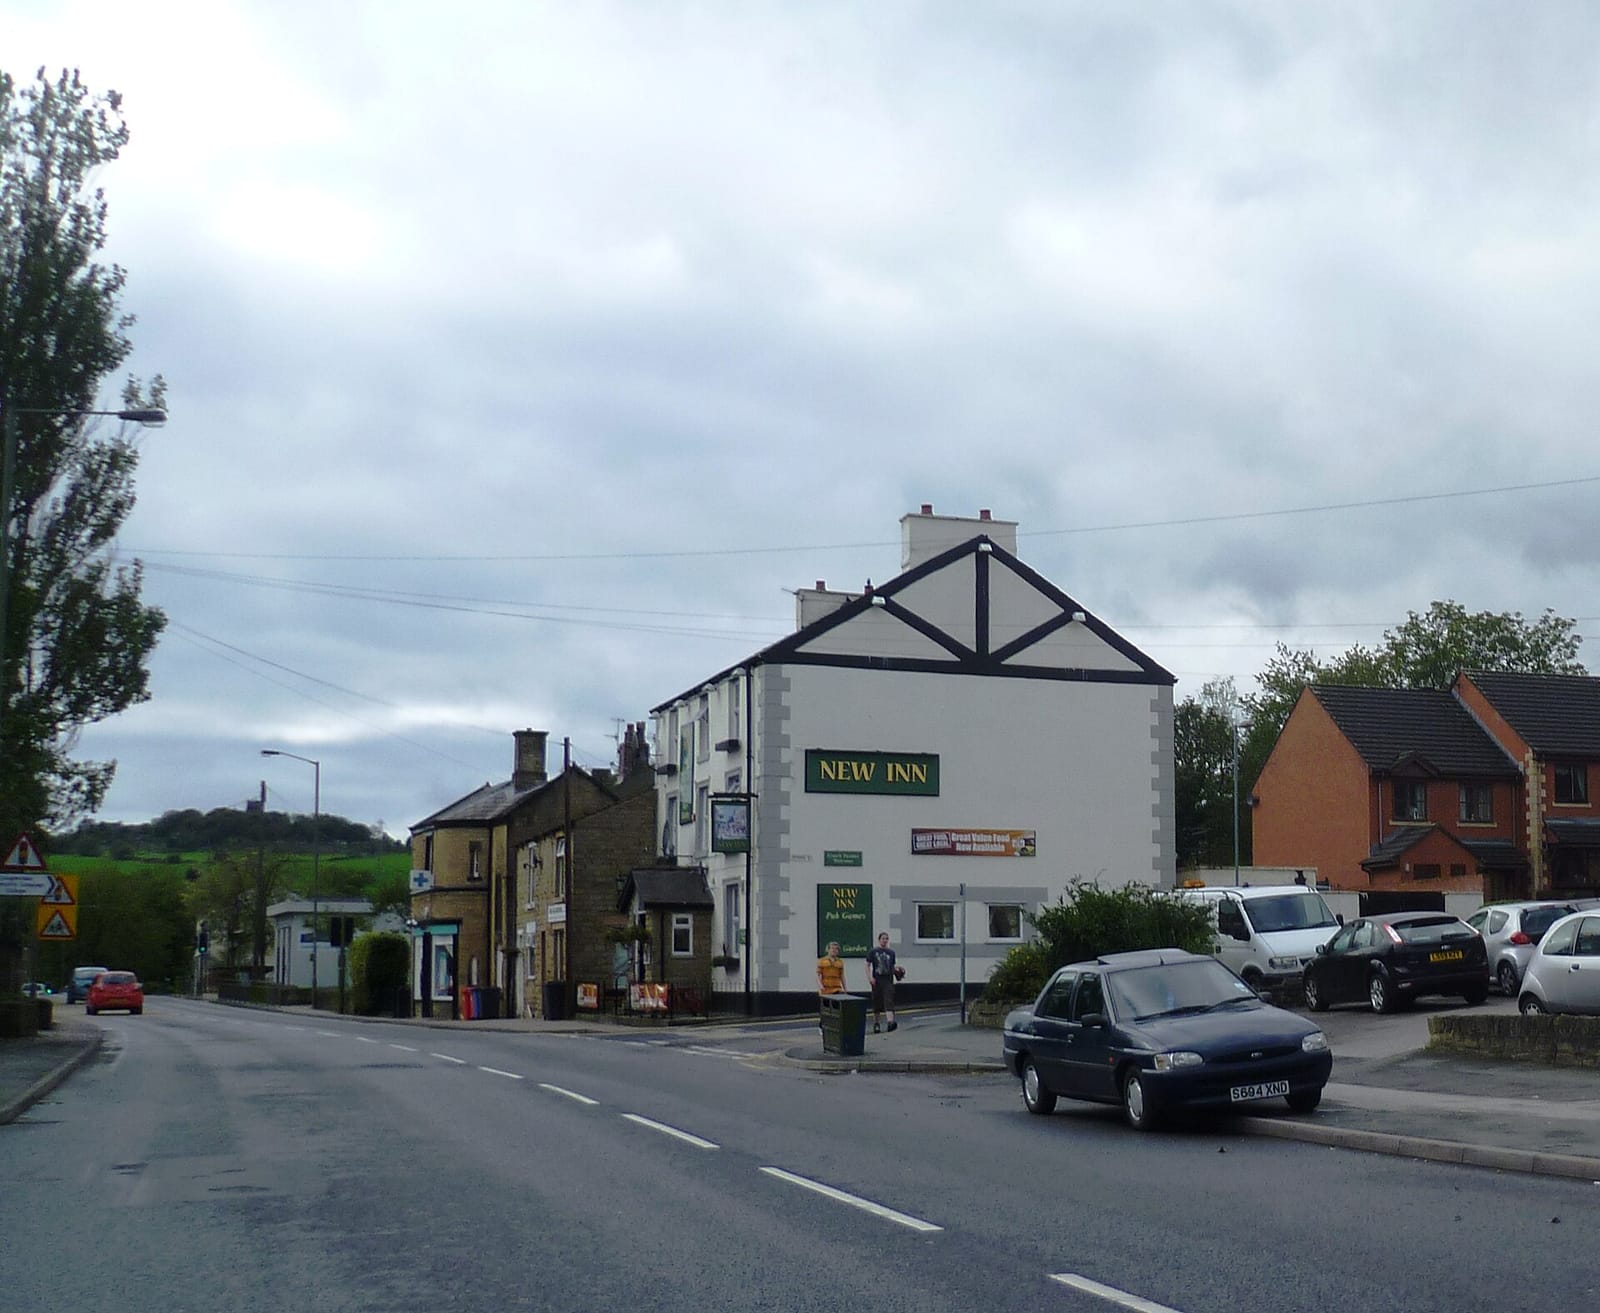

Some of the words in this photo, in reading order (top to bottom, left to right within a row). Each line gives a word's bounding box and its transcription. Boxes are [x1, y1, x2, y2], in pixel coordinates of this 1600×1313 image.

[820, 760, 875, 782] NEW
[886, 762, 927, 784] INN
[833, 888, 858, 898] NEW
[836, 899, 855, 909] INN
[1233, 1085, 1262, 1099] S694
[1265, 1081, 1288, 1096] XND
